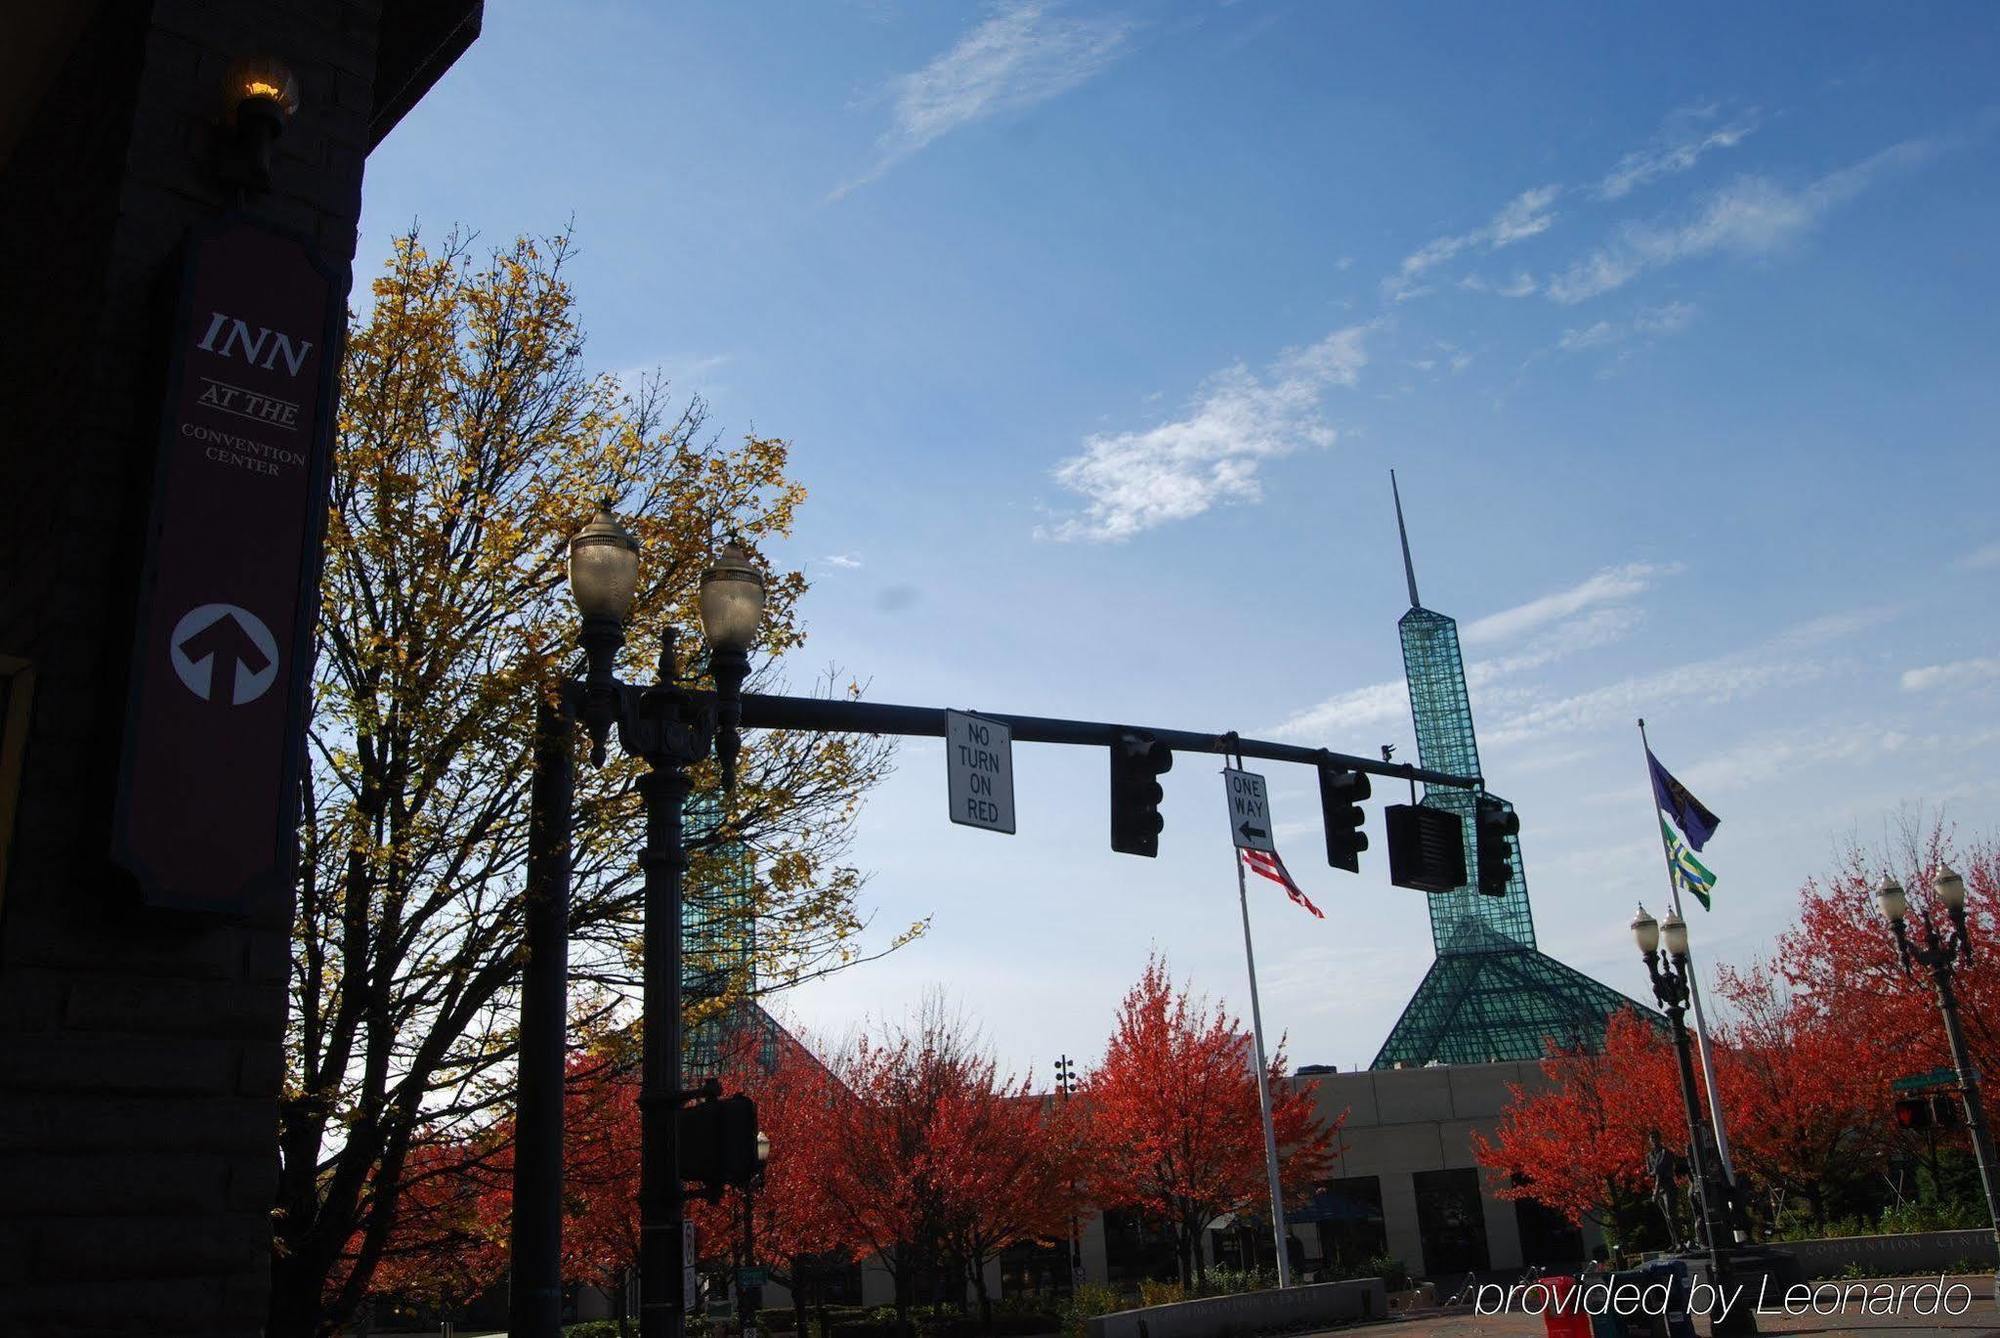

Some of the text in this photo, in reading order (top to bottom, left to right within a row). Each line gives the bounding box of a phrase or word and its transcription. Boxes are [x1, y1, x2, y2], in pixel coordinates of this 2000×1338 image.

[196, 311, 313, 377] INN
[200, 383, 298, 425] AT THE
[181, 423, 305, 468] CONVENTION
[206, 446, 280, 477] CENTER
[967, 722, 989, 746] NO
[958, 744, 999, 774] TURN
[970, 773, 991, 797] ON
[1233, 776, 1261, 798] ONE
[967, 798, 998, 823] RED
[1234, 796, 1263, 818] WAY
